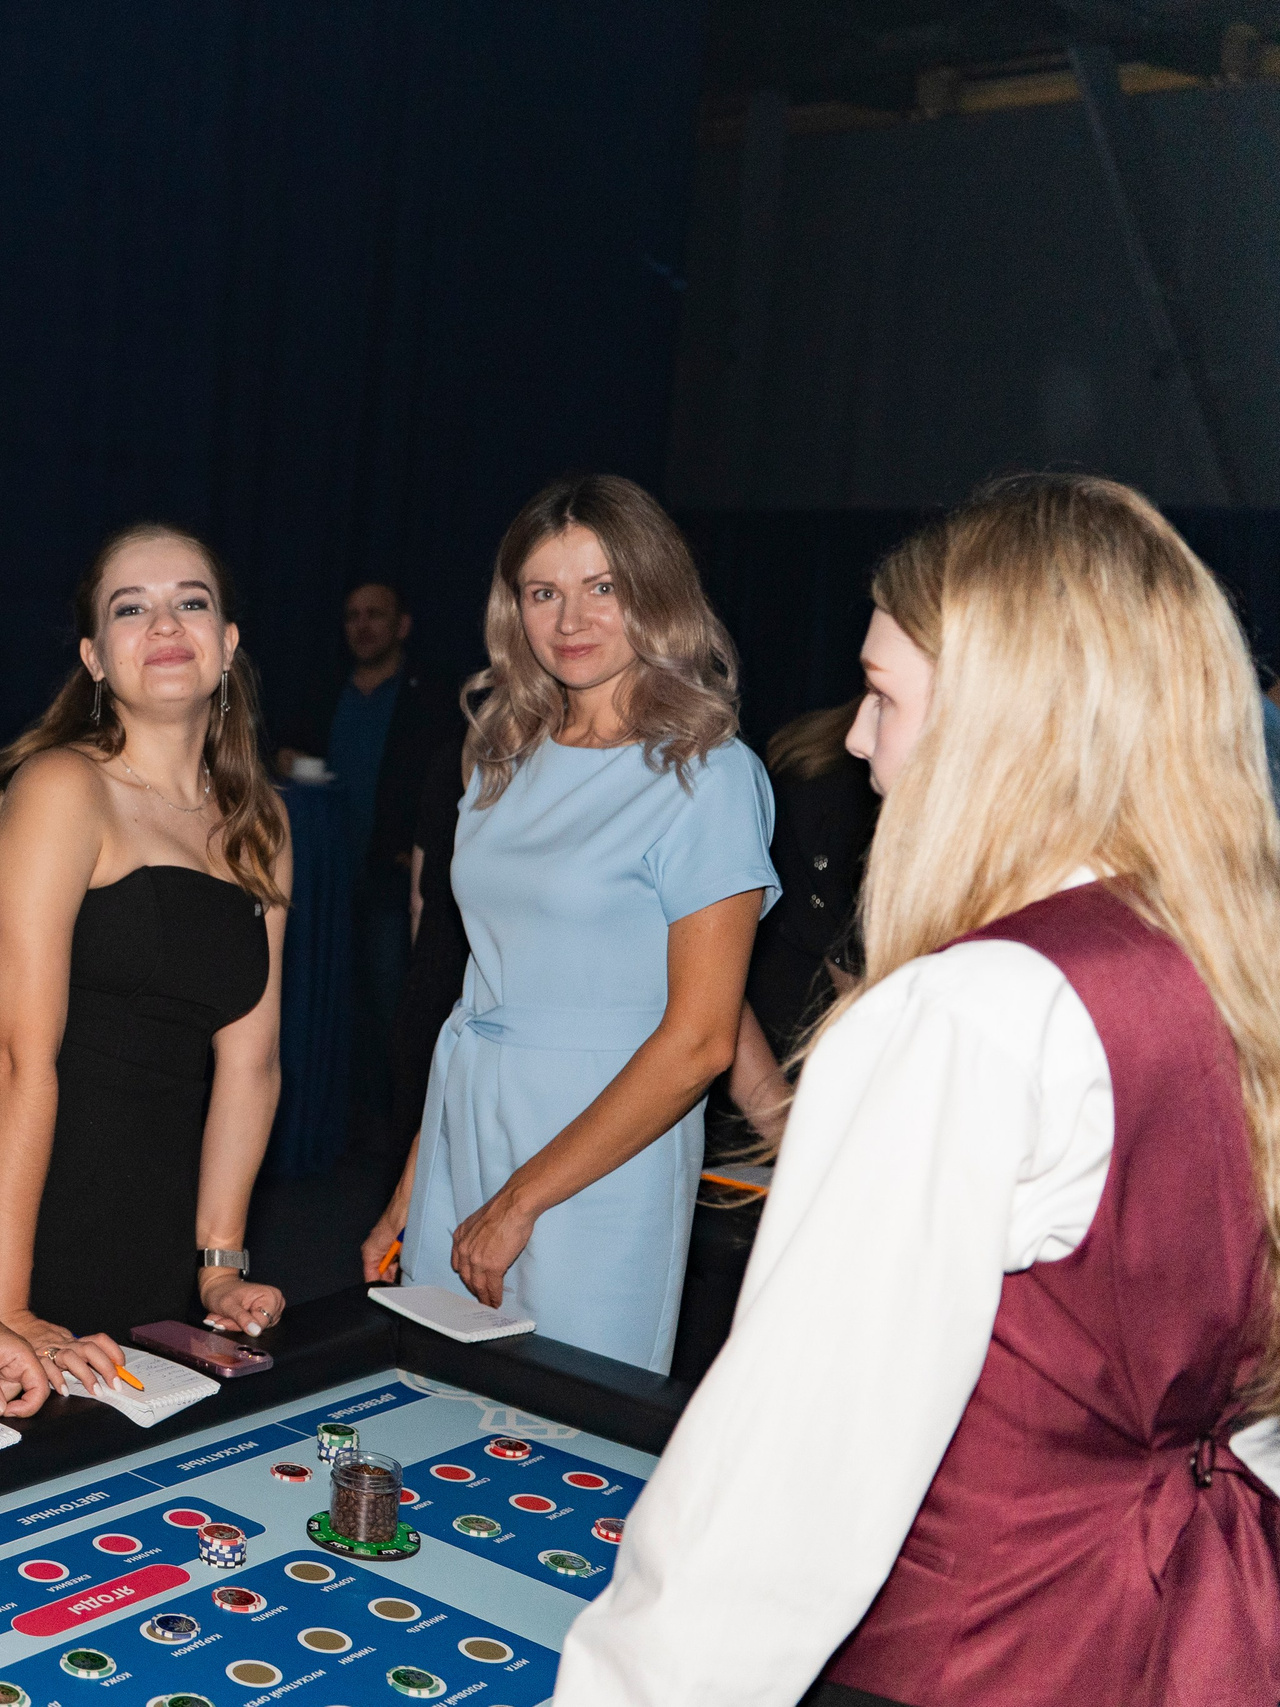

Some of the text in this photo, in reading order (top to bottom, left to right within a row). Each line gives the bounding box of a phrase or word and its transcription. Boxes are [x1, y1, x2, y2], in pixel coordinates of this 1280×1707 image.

[327, 1392, 397, 1419] ДРЕВЕСНЫЕ
[177, 1441, 258, 1471] МУСКАТНЫЕ
[17, 1491, 110, 1526] ЦВЕТОЧНЫЕ
[411, 1500, 434, 1510] КИВИ
[545, 1507, 574, 1520] ПЕРСИК
[493, 1532, 515, 1544] ЛИЧИ
[123, 1547, 162, 1563] МАЛИНА
[46, 1574, 92, 1592] ЕЖЕВИКА
[320, 1576, 356, 1593] КОРИЦА
[67, 1585, 135, 1615] ЯГОДЫ
[251, 1605, 288, 1622] ВАНИЛЬ
[406, 1613, 448, 1633] МИНДАЛЬ
[171, 1633, 223, 1657] КАРДАМОН
[338, 1646, 377, 1665] ТИМЬЯН
[503, 1658, 530, 1672] МЯТА
[100, 1671, 133, 1687] КОЖА
[243, 1669, 326, 1707] МУСКАТНЫЙ ОРЕХ
[444, 1681, 488, 1706] РОЗОВЫЙ
